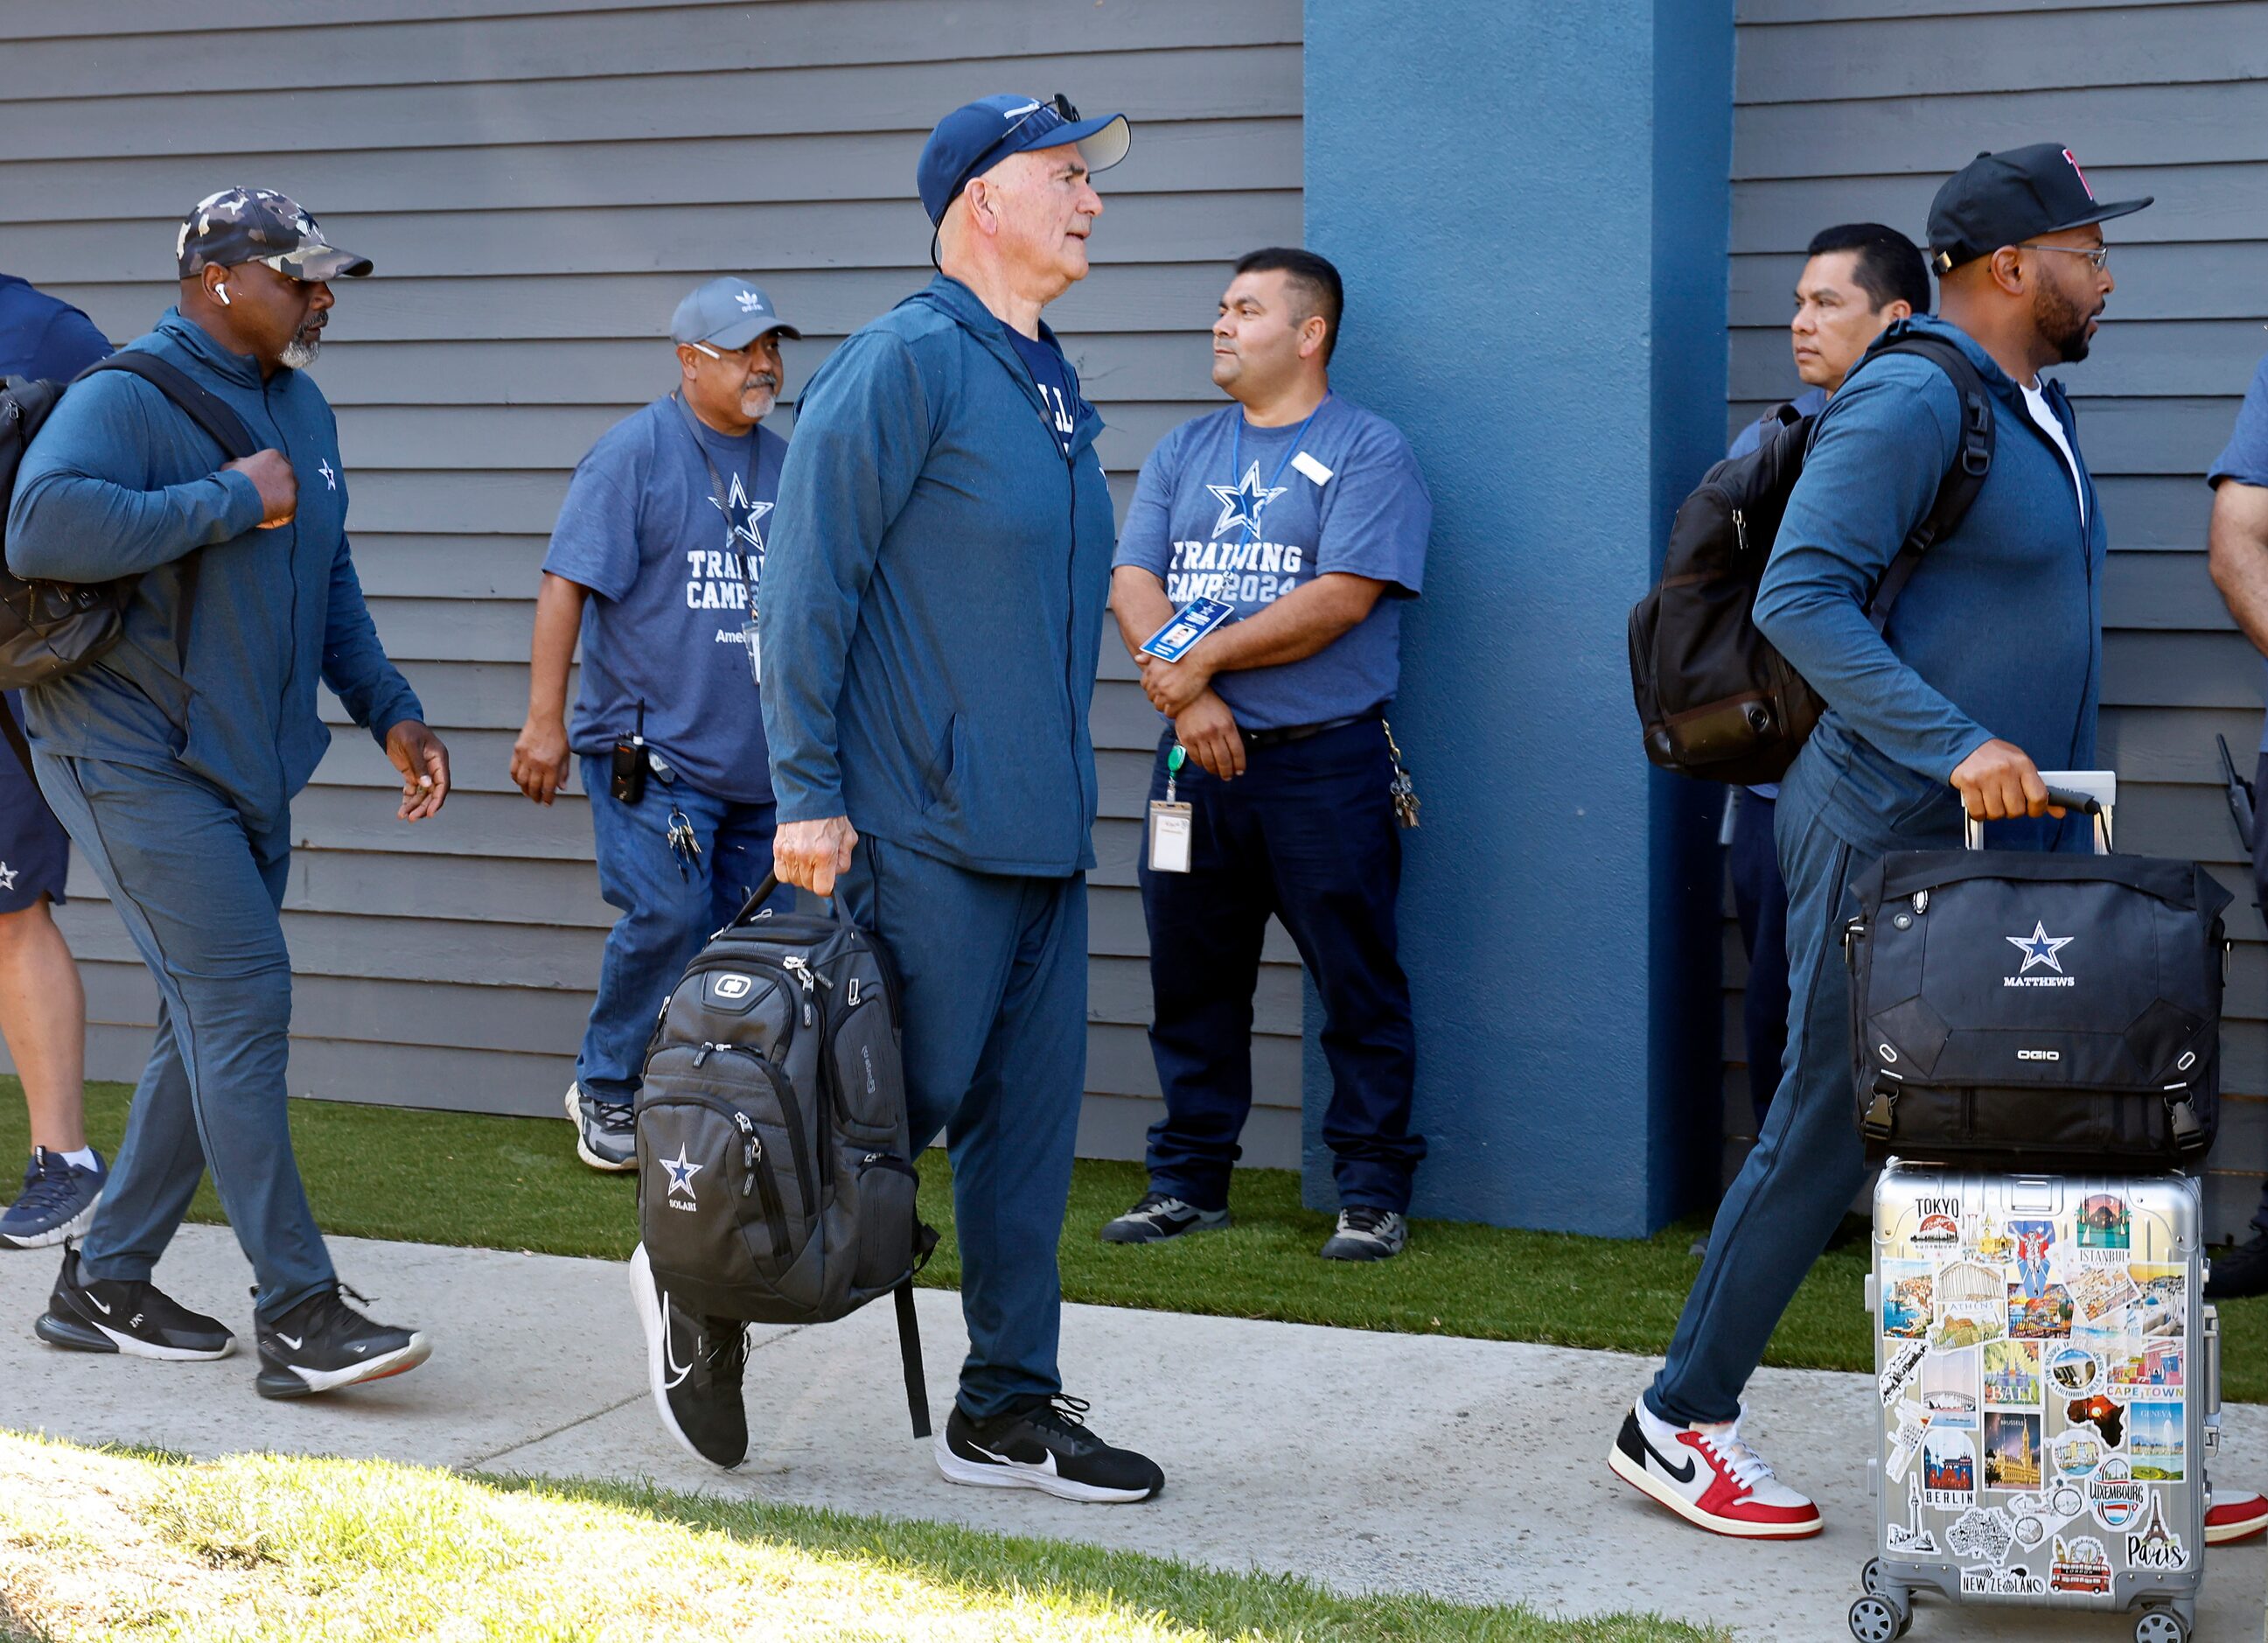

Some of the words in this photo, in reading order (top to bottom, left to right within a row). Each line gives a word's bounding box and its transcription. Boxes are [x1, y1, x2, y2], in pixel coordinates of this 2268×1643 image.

[1170, 541, 1303, 574] TRAINING
[687, 581, 749, 610] CAMP
[1167, 573, 1222, 602] CAMP
[1221, 573, 1296, 604] 2024
[2003, 976, 2075, 988] MATTHEWS
[2017, 1050, 2060, 1060] OGIO
[1915, 1198, 1959, 1218] TOKYO
[2080, 1250, 2126, 1262] ISTANBUL
[1950, 1302, 1994, 1311] ATHENS
[1991, 1385, 2034, 1401] BALI
[2106, 1387, 2139, 1396] CAPE
[2145, 1388, 2184, 1397] TOWN
[2140, 1409, 2173, 1418] GENEVA
[1926, 1492, 1973, 1504] BERLIN
[2090, 1481, 2144, 1503] LUXEMBOURG
[2128, 1535, 2187, 1569] Paris
[1963, 1577, 1985, 1592] NEW
